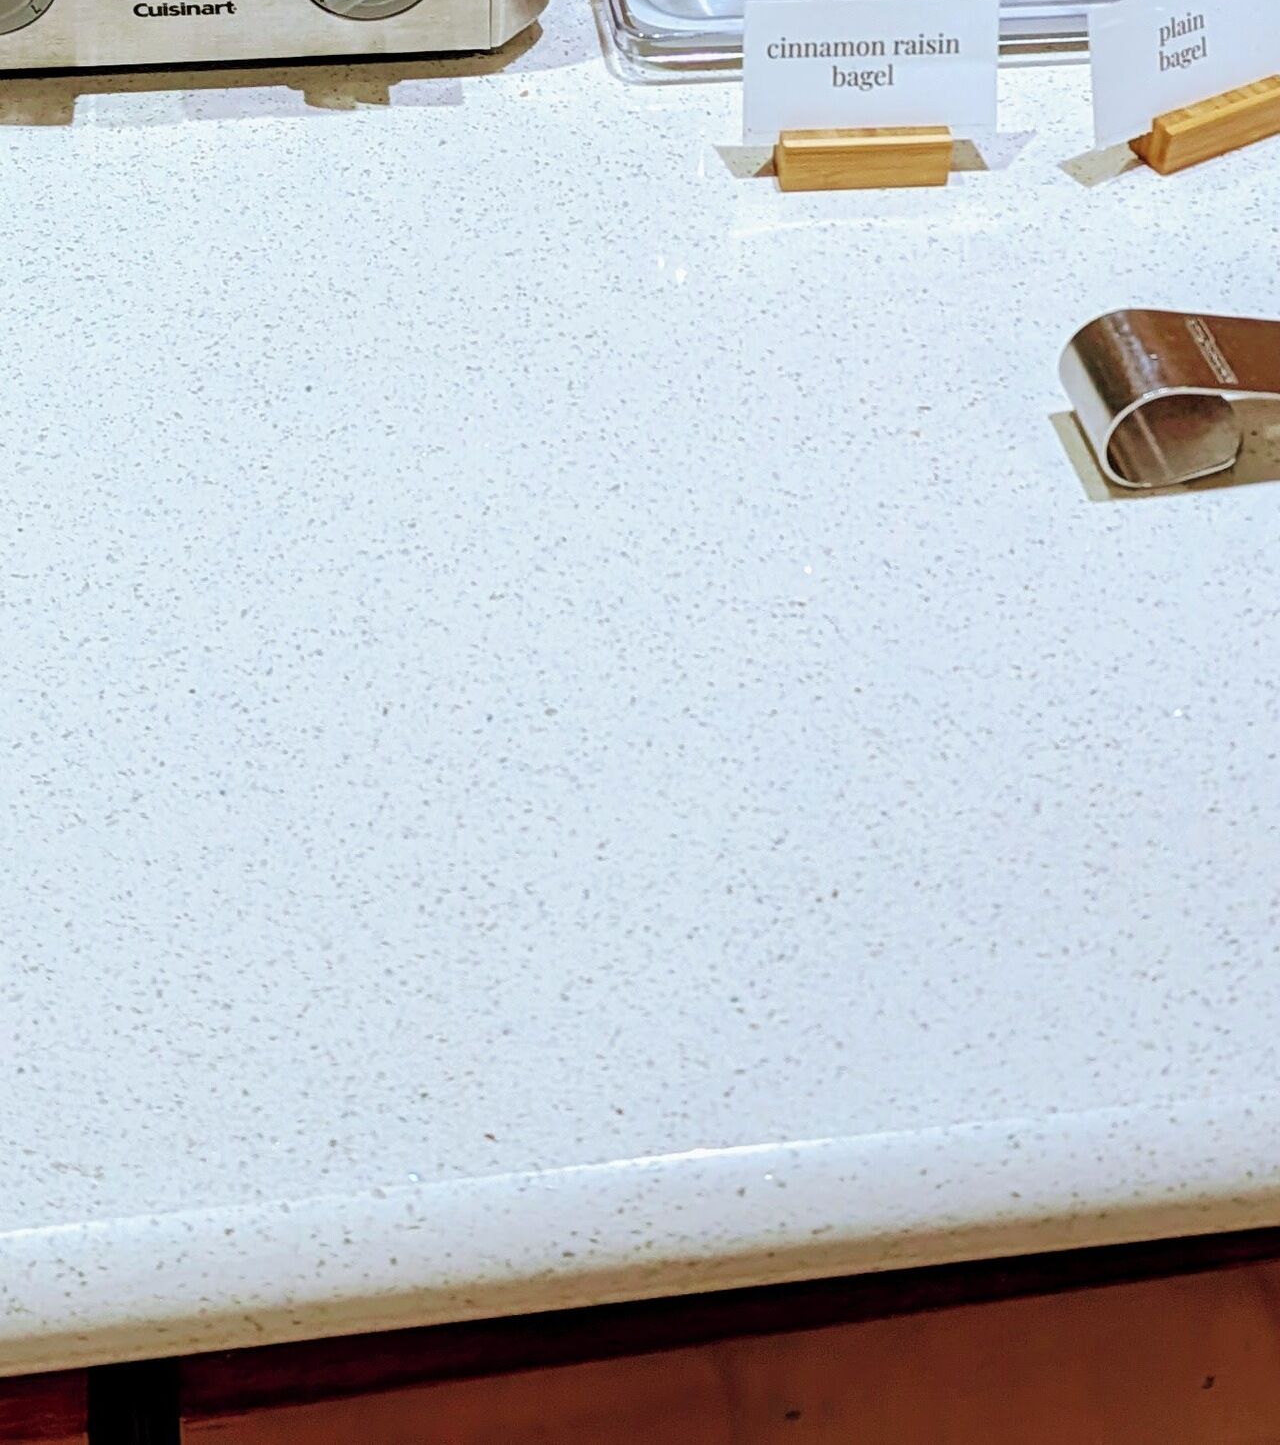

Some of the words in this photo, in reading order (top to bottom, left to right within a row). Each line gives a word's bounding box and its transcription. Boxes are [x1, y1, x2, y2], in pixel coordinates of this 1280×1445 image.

[31, 4, 42, 15] 7
[132, 0, 237, 18] Cuisinart
[1159, 11, 1205, 47] plain
[767, 36, 886, 60] cinnamon
[892, 32, 961, 56] raisin
[1159, 35, 1207, 72] bagel
[831, 63, 895, 92] bagel
